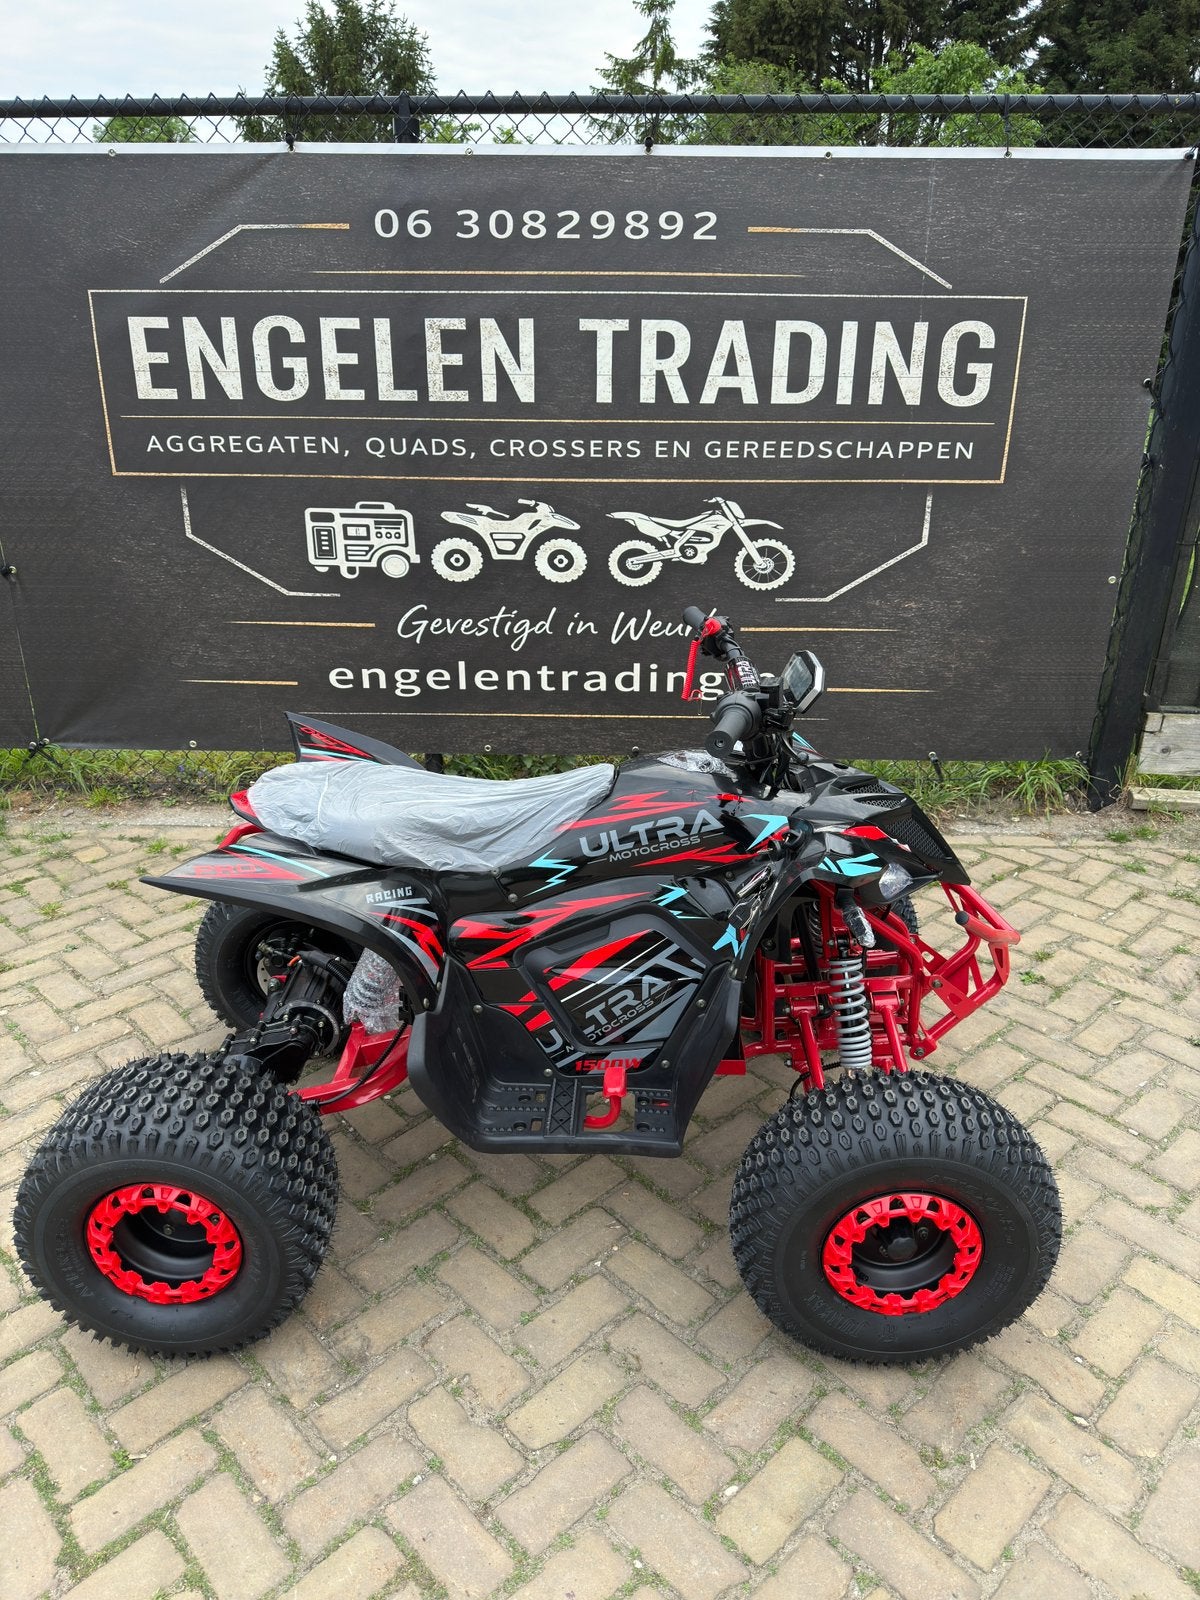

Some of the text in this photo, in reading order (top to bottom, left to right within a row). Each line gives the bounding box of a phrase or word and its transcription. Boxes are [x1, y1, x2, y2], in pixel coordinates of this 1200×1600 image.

[374, 208, 718, 241] 06 30829892
[127, 314, 996, 408] ENGELEN TRADING
[146, 435, 974, 460] AGGREGATEN, QUADS, CROSSERS EN GEREEDSCHAPPEN
[397, 604, 557, 652] Gevestigd
[566, 612, 600, 637] in
[579, 808, 725, 858] ULTRA
[609, 835, 701, 862] MOTOCROSS
[192, 863, 257, 879] PRO
[365, 886, 413, 904] RACING
[575, 1057, 643, 1072] 1500W
